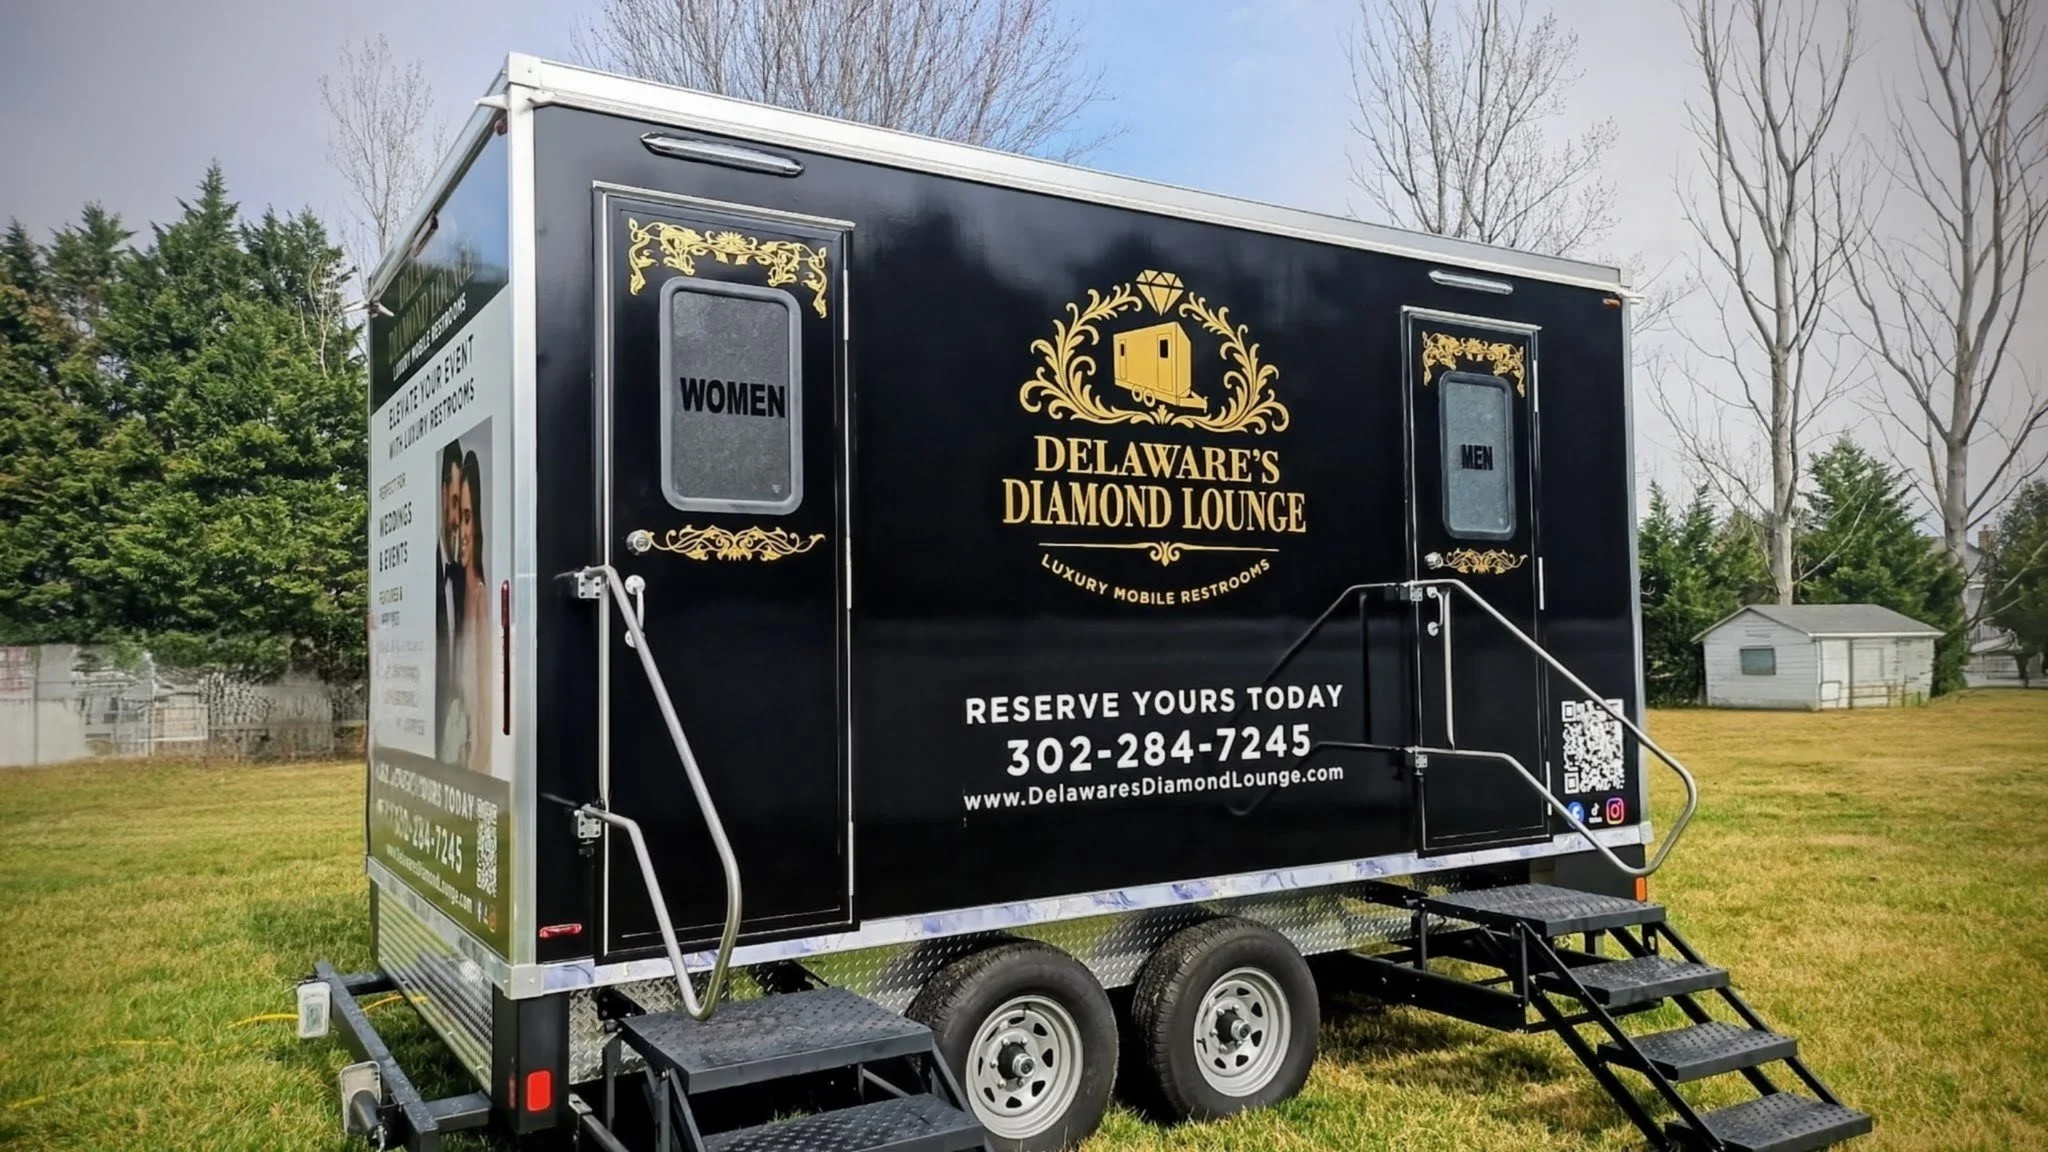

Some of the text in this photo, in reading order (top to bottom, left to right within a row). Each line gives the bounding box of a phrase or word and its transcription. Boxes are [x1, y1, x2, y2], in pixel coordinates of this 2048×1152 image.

[431, 291, 467, 345] RESTROOMS
[388, 333, 474, 431] ELEVATE YOUR EVENT
[430, 377, 475, 431] RESTROOMS
[680, 377, 786, 418] WOMEN
[1034, 434, 1281, 485] DELAWARE'S
[1461, 444, 1494, 471] MEN
[1002, 478, 1307, 533] DIAMOND LOUNGE
[384, 540, 408, 571] EVENTS
[1041, 553, 1271, 606] LUXURY MOBILE RESTROOMS
[965, 684, 1344, 725] RESERVE YOURS TODAY
[1006, 723, 1312, 776] 302-284-7245
[444, 783, 475, 821] TODAY
[964, 765, 1344, 812] www.DelawaresDiamondLounge.com
